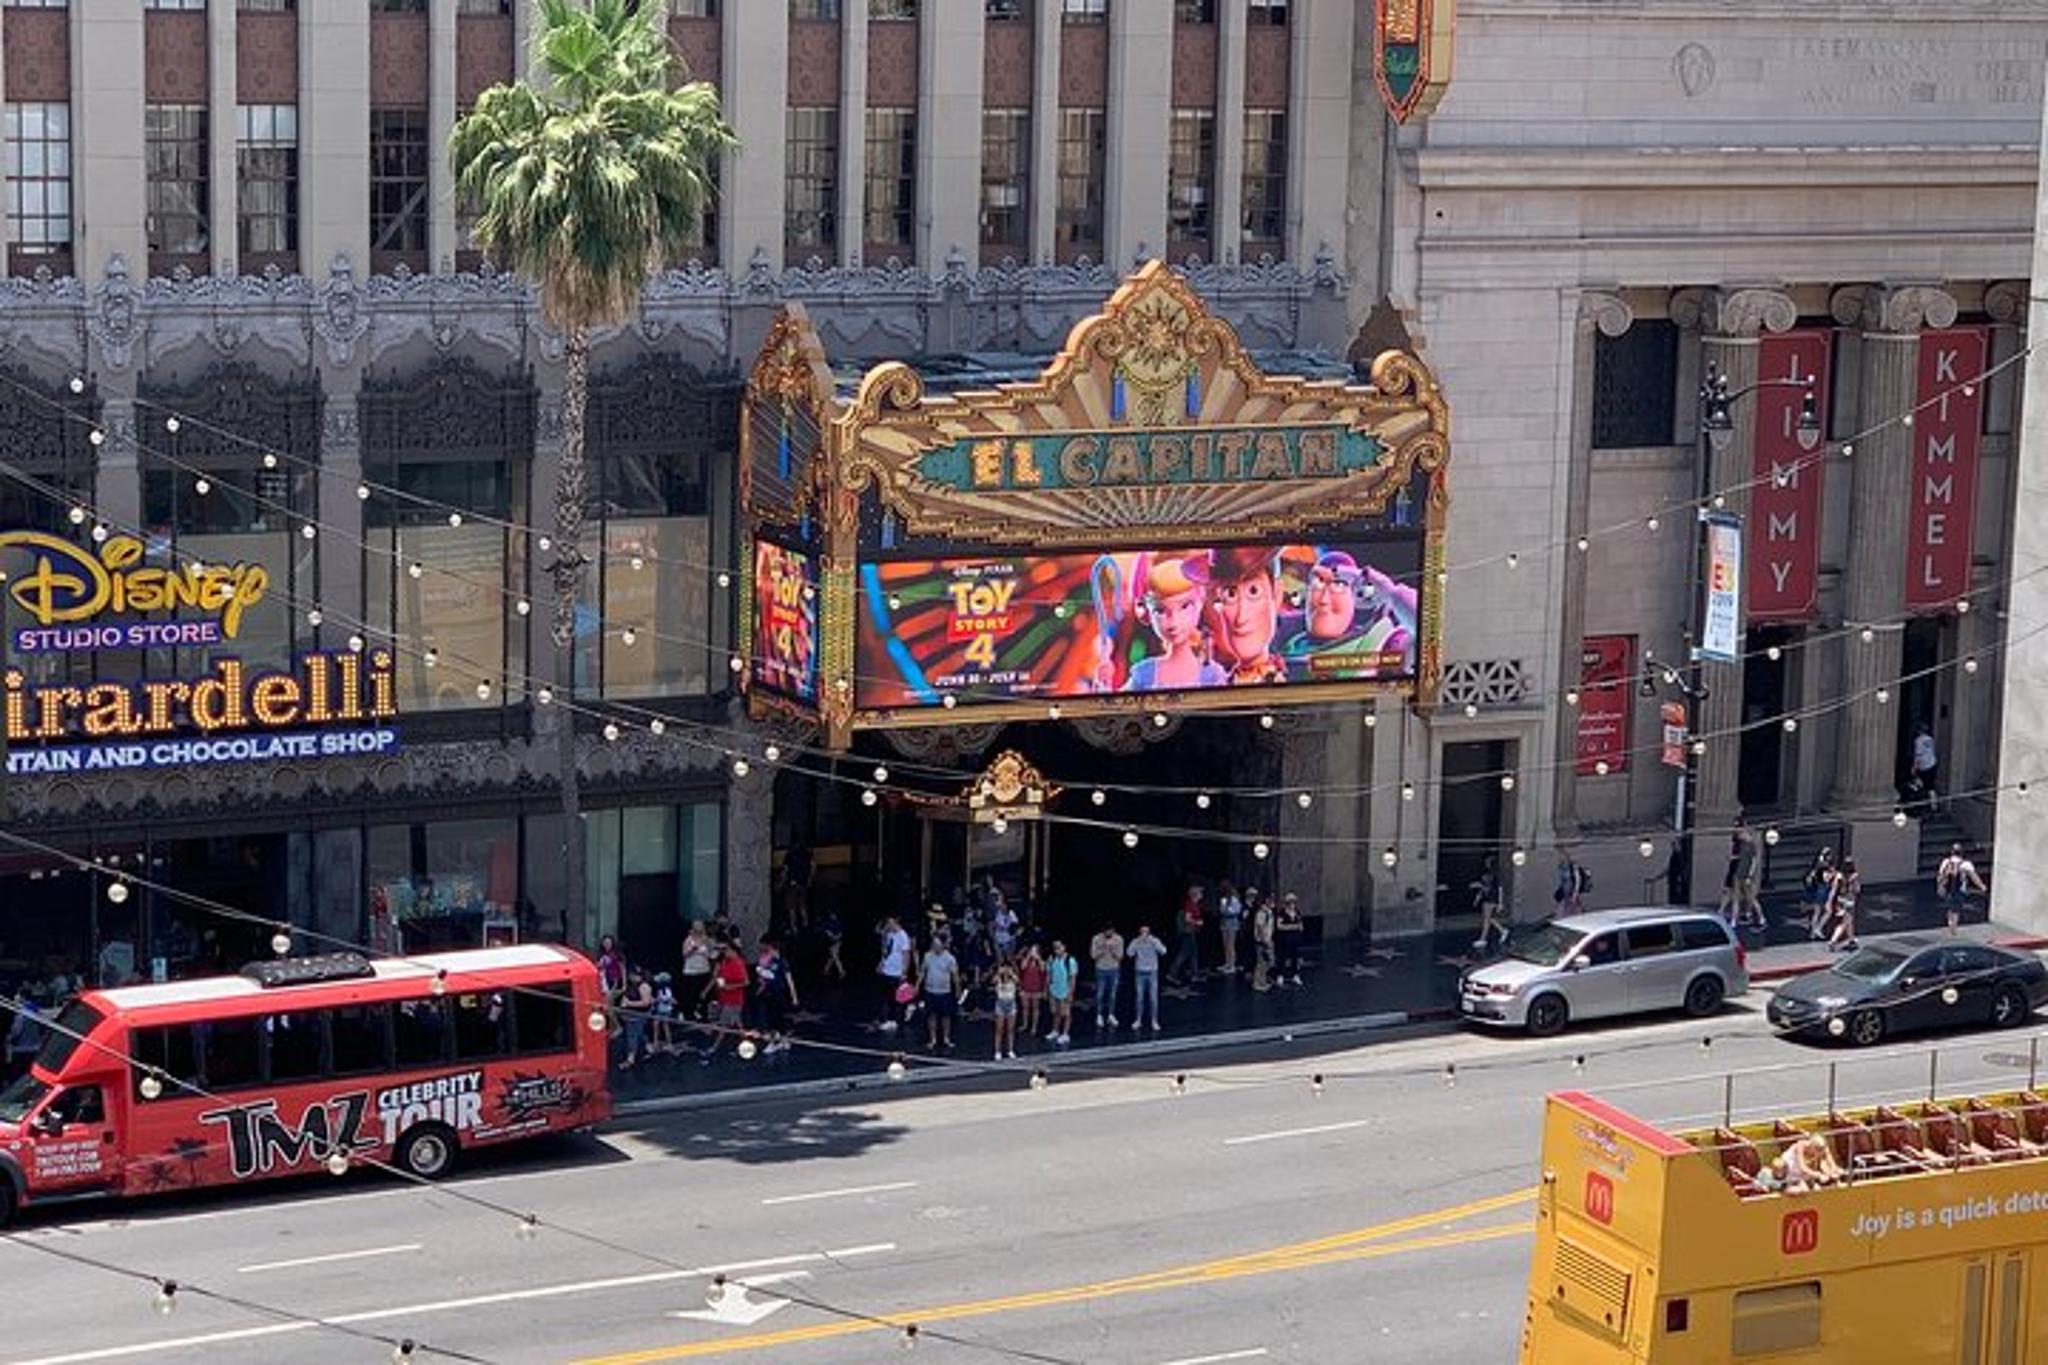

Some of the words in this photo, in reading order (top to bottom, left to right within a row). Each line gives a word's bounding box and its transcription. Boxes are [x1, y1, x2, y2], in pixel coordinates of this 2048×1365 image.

[970, 438, 1041, 486] EL
[1059, 429, 1340, 486] CAPITAN
[1767, 353, 1799, 592] JIMMY
[1923, 350, 1957, 587] KIMMEL
[0, 531, 269, 638] Disney
[948, 579, 1017, 616] TOY
[19, 627, 122, 650] STUDIO
[127, 622, 219, 645] STORE
[955, 617, 1009, 632] STORY
[965, 633, 996, 669] 4
[85, 744, 147, 769] AND
[150, 735, 317, 766] CHOCOLATE
[320, 730, 394, 755] SHOP
[378, 1071, 483, 1108] CELEBRITY
[199, 1088, 381, 1179] TMZ
[379, 1092, 484, 1145] TOUR
[1850, 1213, 1891, 1238] Joy
[1896, 1208, 1915, 1229] is
[1921, 1208, 1934, 1226] a
[1939, 1195, 1998, 1229] quick
